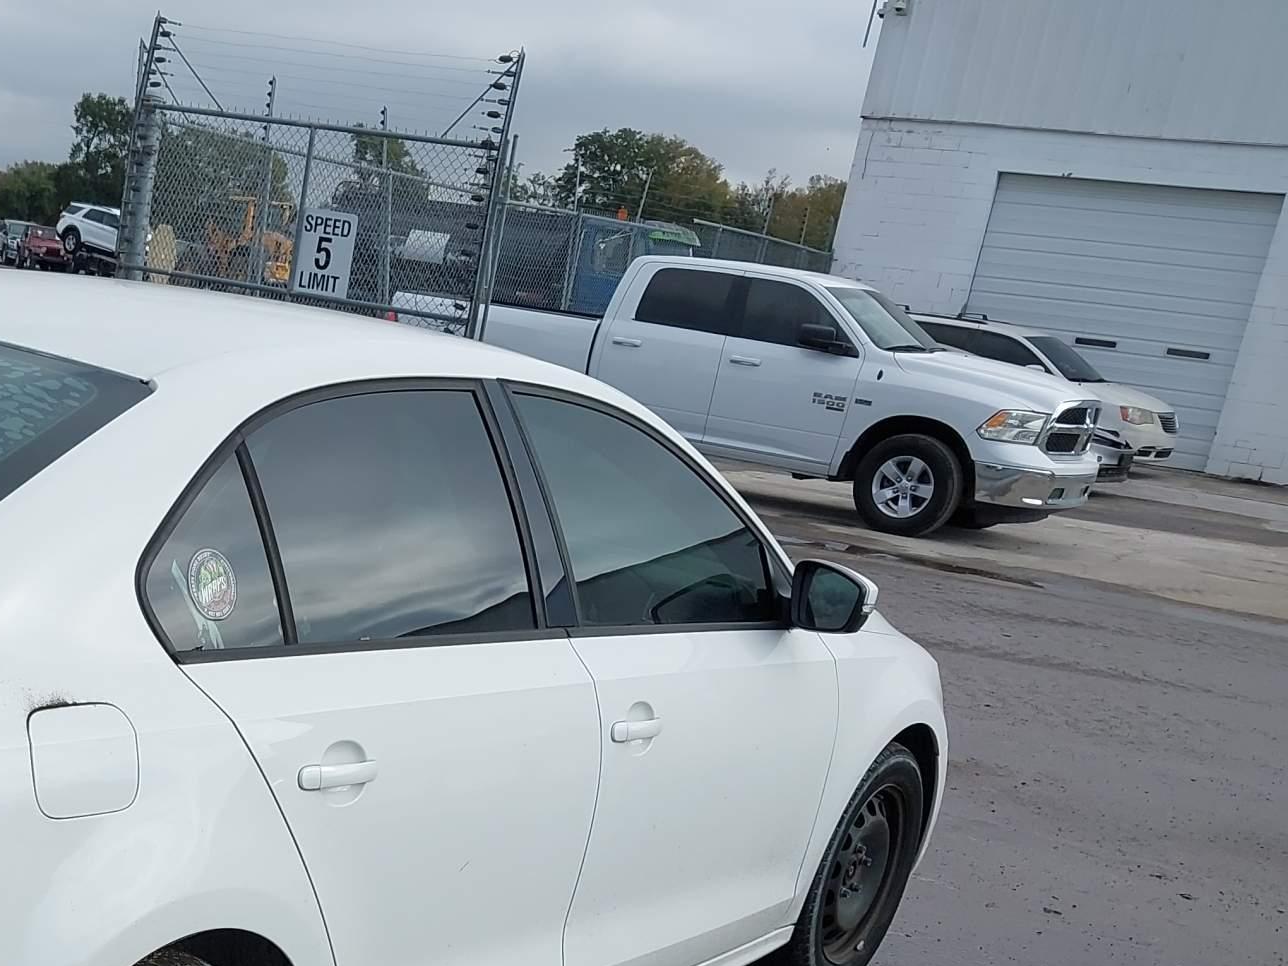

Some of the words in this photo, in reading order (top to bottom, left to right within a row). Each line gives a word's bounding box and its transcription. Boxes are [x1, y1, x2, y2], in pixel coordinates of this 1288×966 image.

[304, 214, 352, 238] SPEED
[314, 236, 333, 270] 5
[298, 270, 340, 293] LIMIT
[812, 398, 846, 408] 1500
